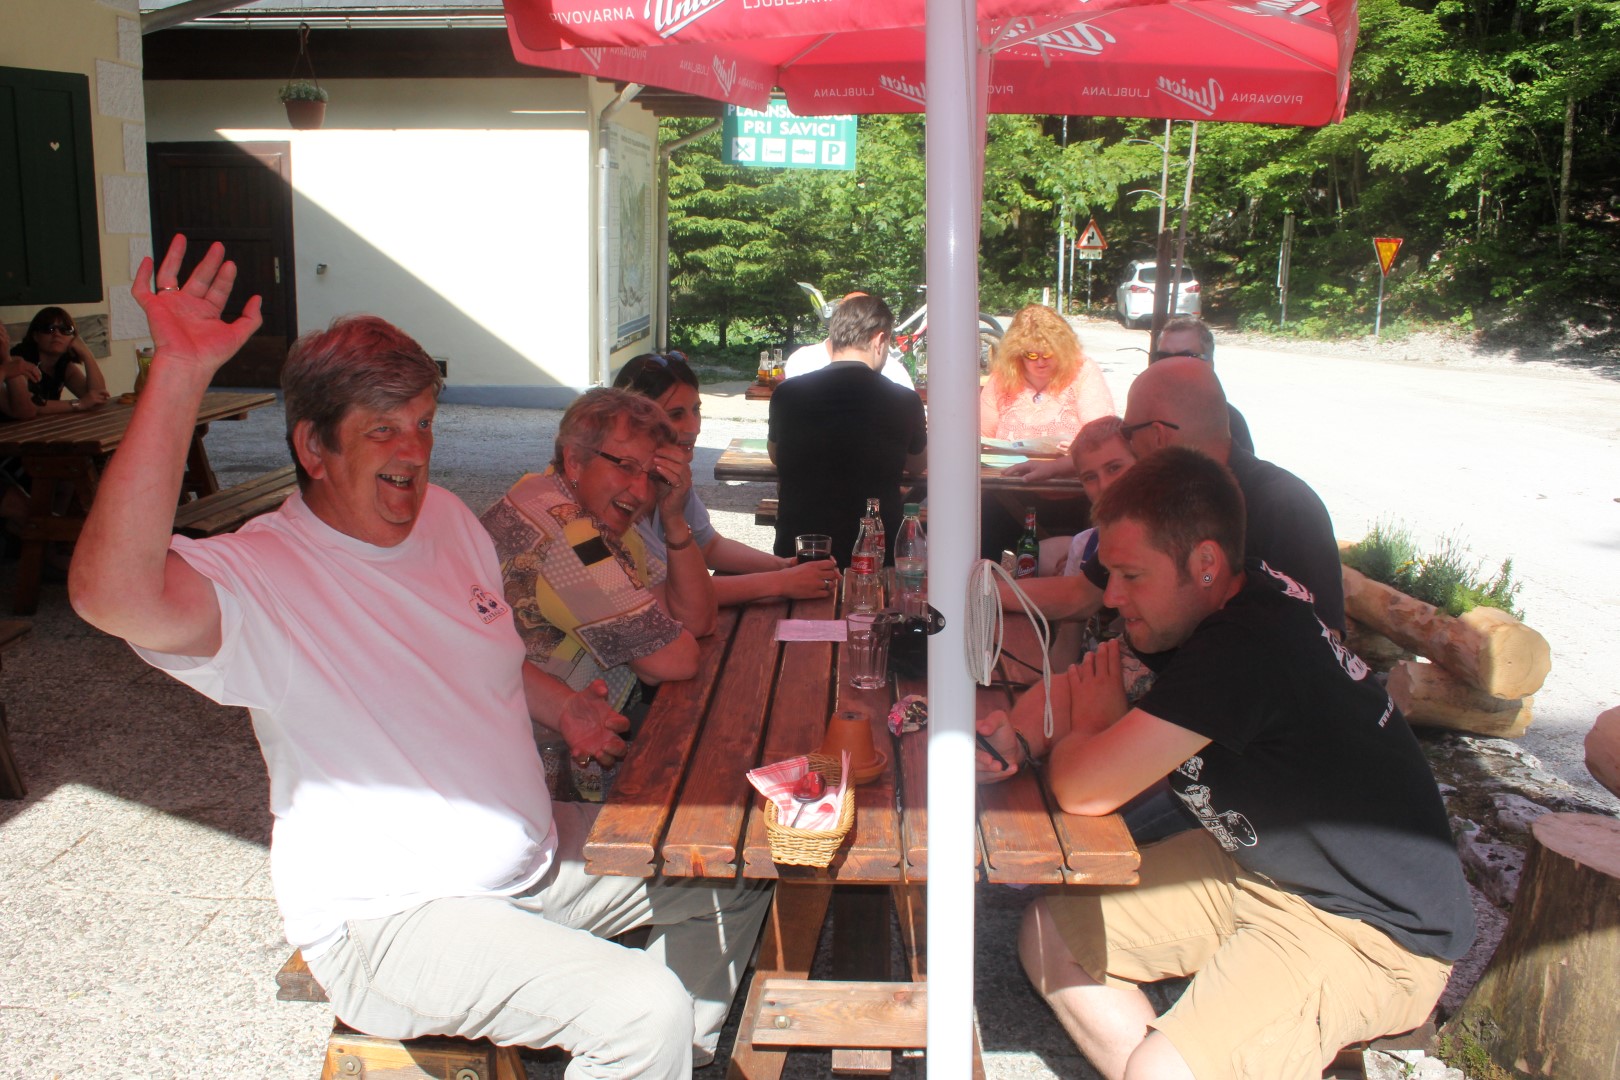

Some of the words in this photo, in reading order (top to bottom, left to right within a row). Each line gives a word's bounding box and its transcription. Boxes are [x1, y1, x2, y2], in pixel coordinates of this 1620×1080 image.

[550, 7, 634, 24] PIVOVARNA
[743, 120, 772, 135] PRI
[779, 121, 836, 137] SAVICI
[827, 143, 840, 162] P
